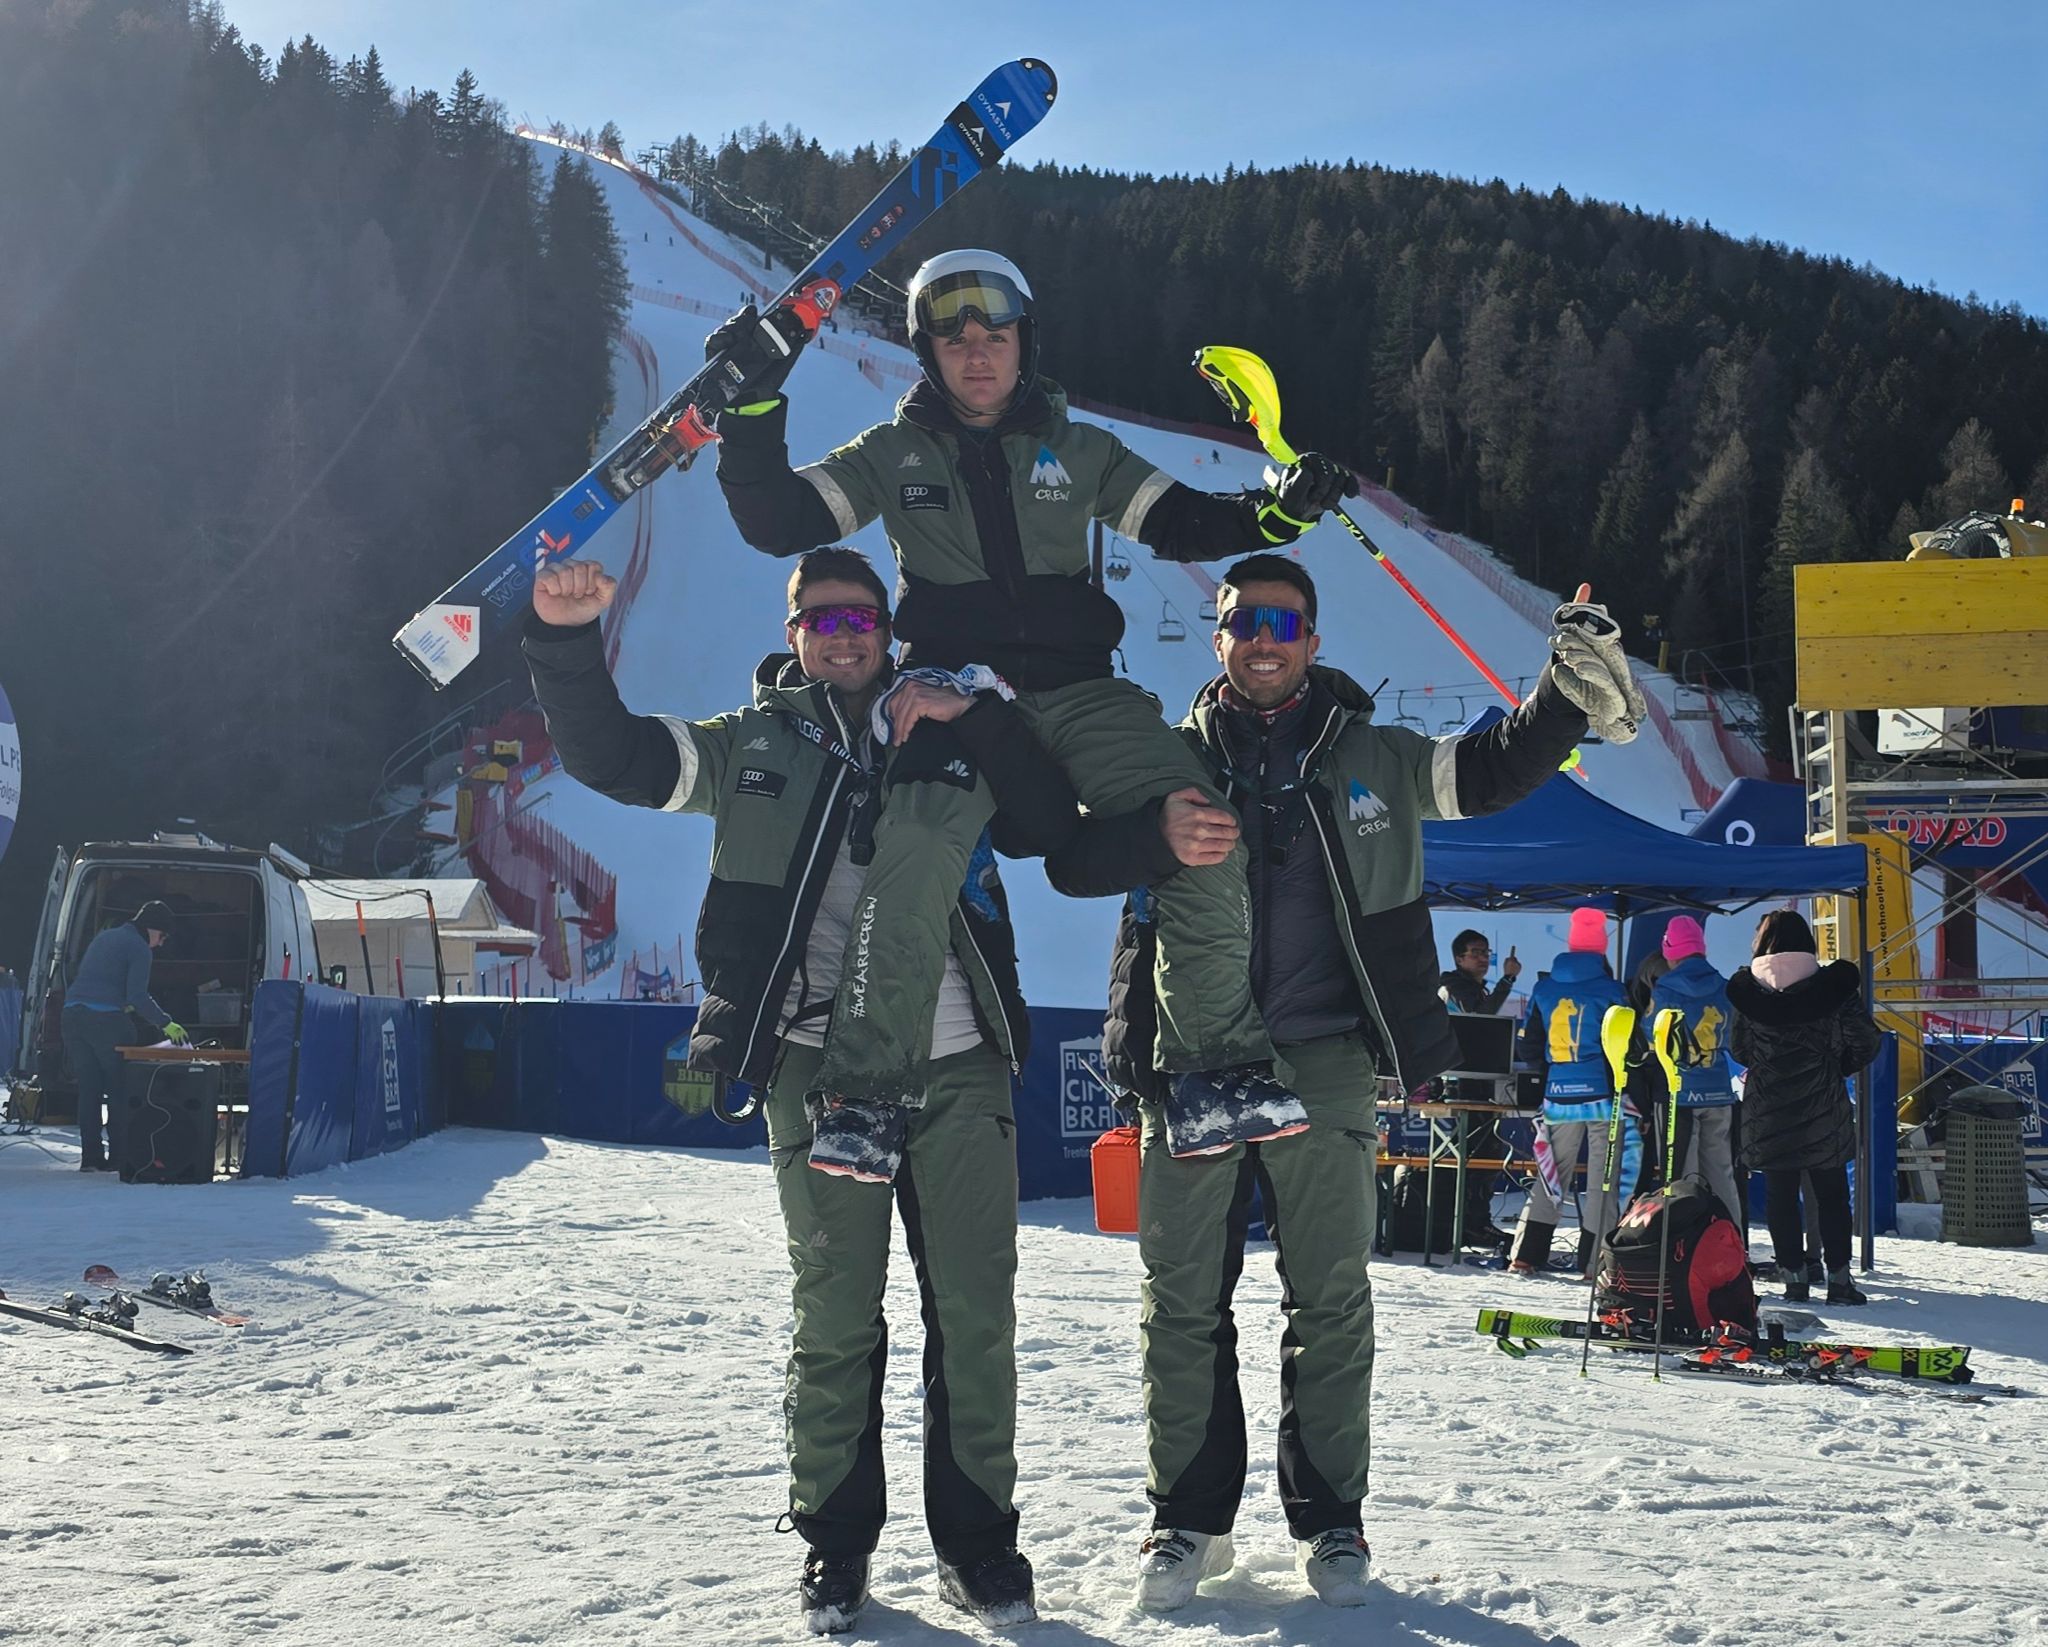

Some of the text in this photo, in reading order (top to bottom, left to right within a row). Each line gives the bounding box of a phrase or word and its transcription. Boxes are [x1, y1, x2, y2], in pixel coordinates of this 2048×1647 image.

[977, 93, 1012, 140] DYNASTAR
[958, 122, 985, 157] DYNASTAR
[1035, 489, 1070, 502] CREW
[1357, 818, 1391, 837] CREW
[1865, 808, 2007, 848] ONAD
[850, 896, 878, 1019] #WEARECREW
[677, 1068, 713, 1083] BIKE
